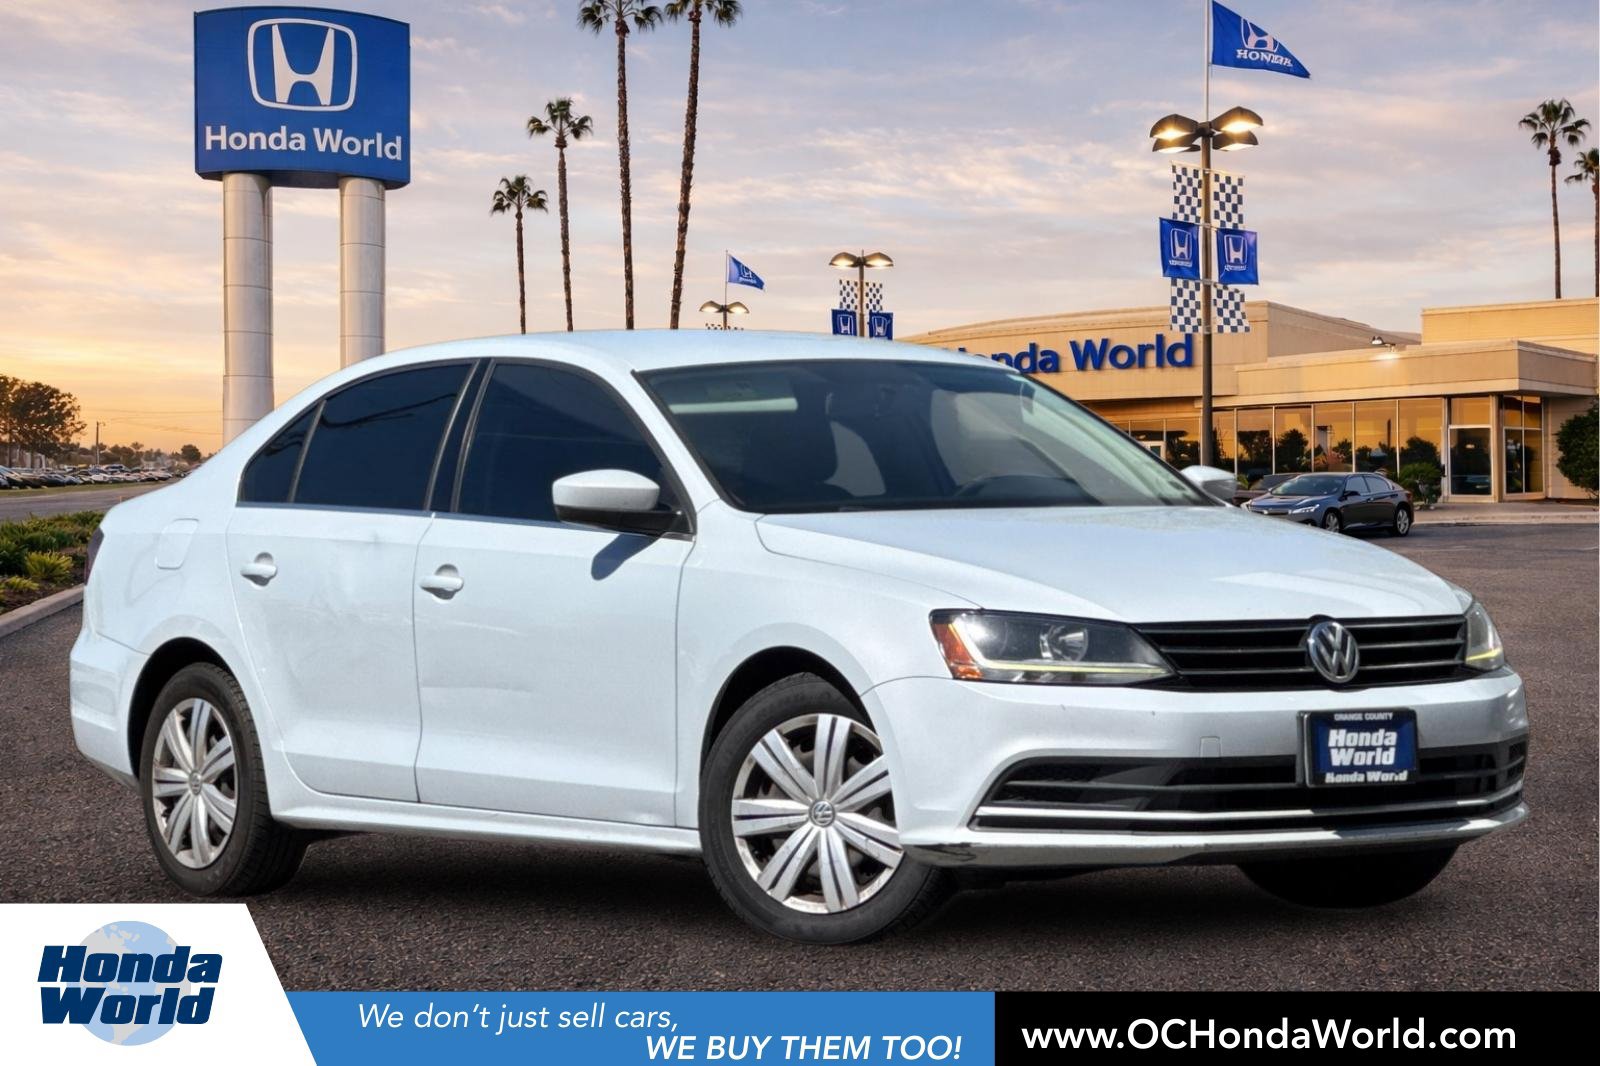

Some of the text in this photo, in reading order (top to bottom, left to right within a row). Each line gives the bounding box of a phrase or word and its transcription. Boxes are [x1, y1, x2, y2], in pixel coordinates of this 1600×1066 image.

[205, 125, 402, 160] Honda World
[958, 333, 1194, 374] nda World
[1364, 712, 1393, 720] COUNTY
[1328, 728, 1397, 747] Honda
[1330, 747, 1396, 766] World
[1325, 771, 1365, 783] Honda
